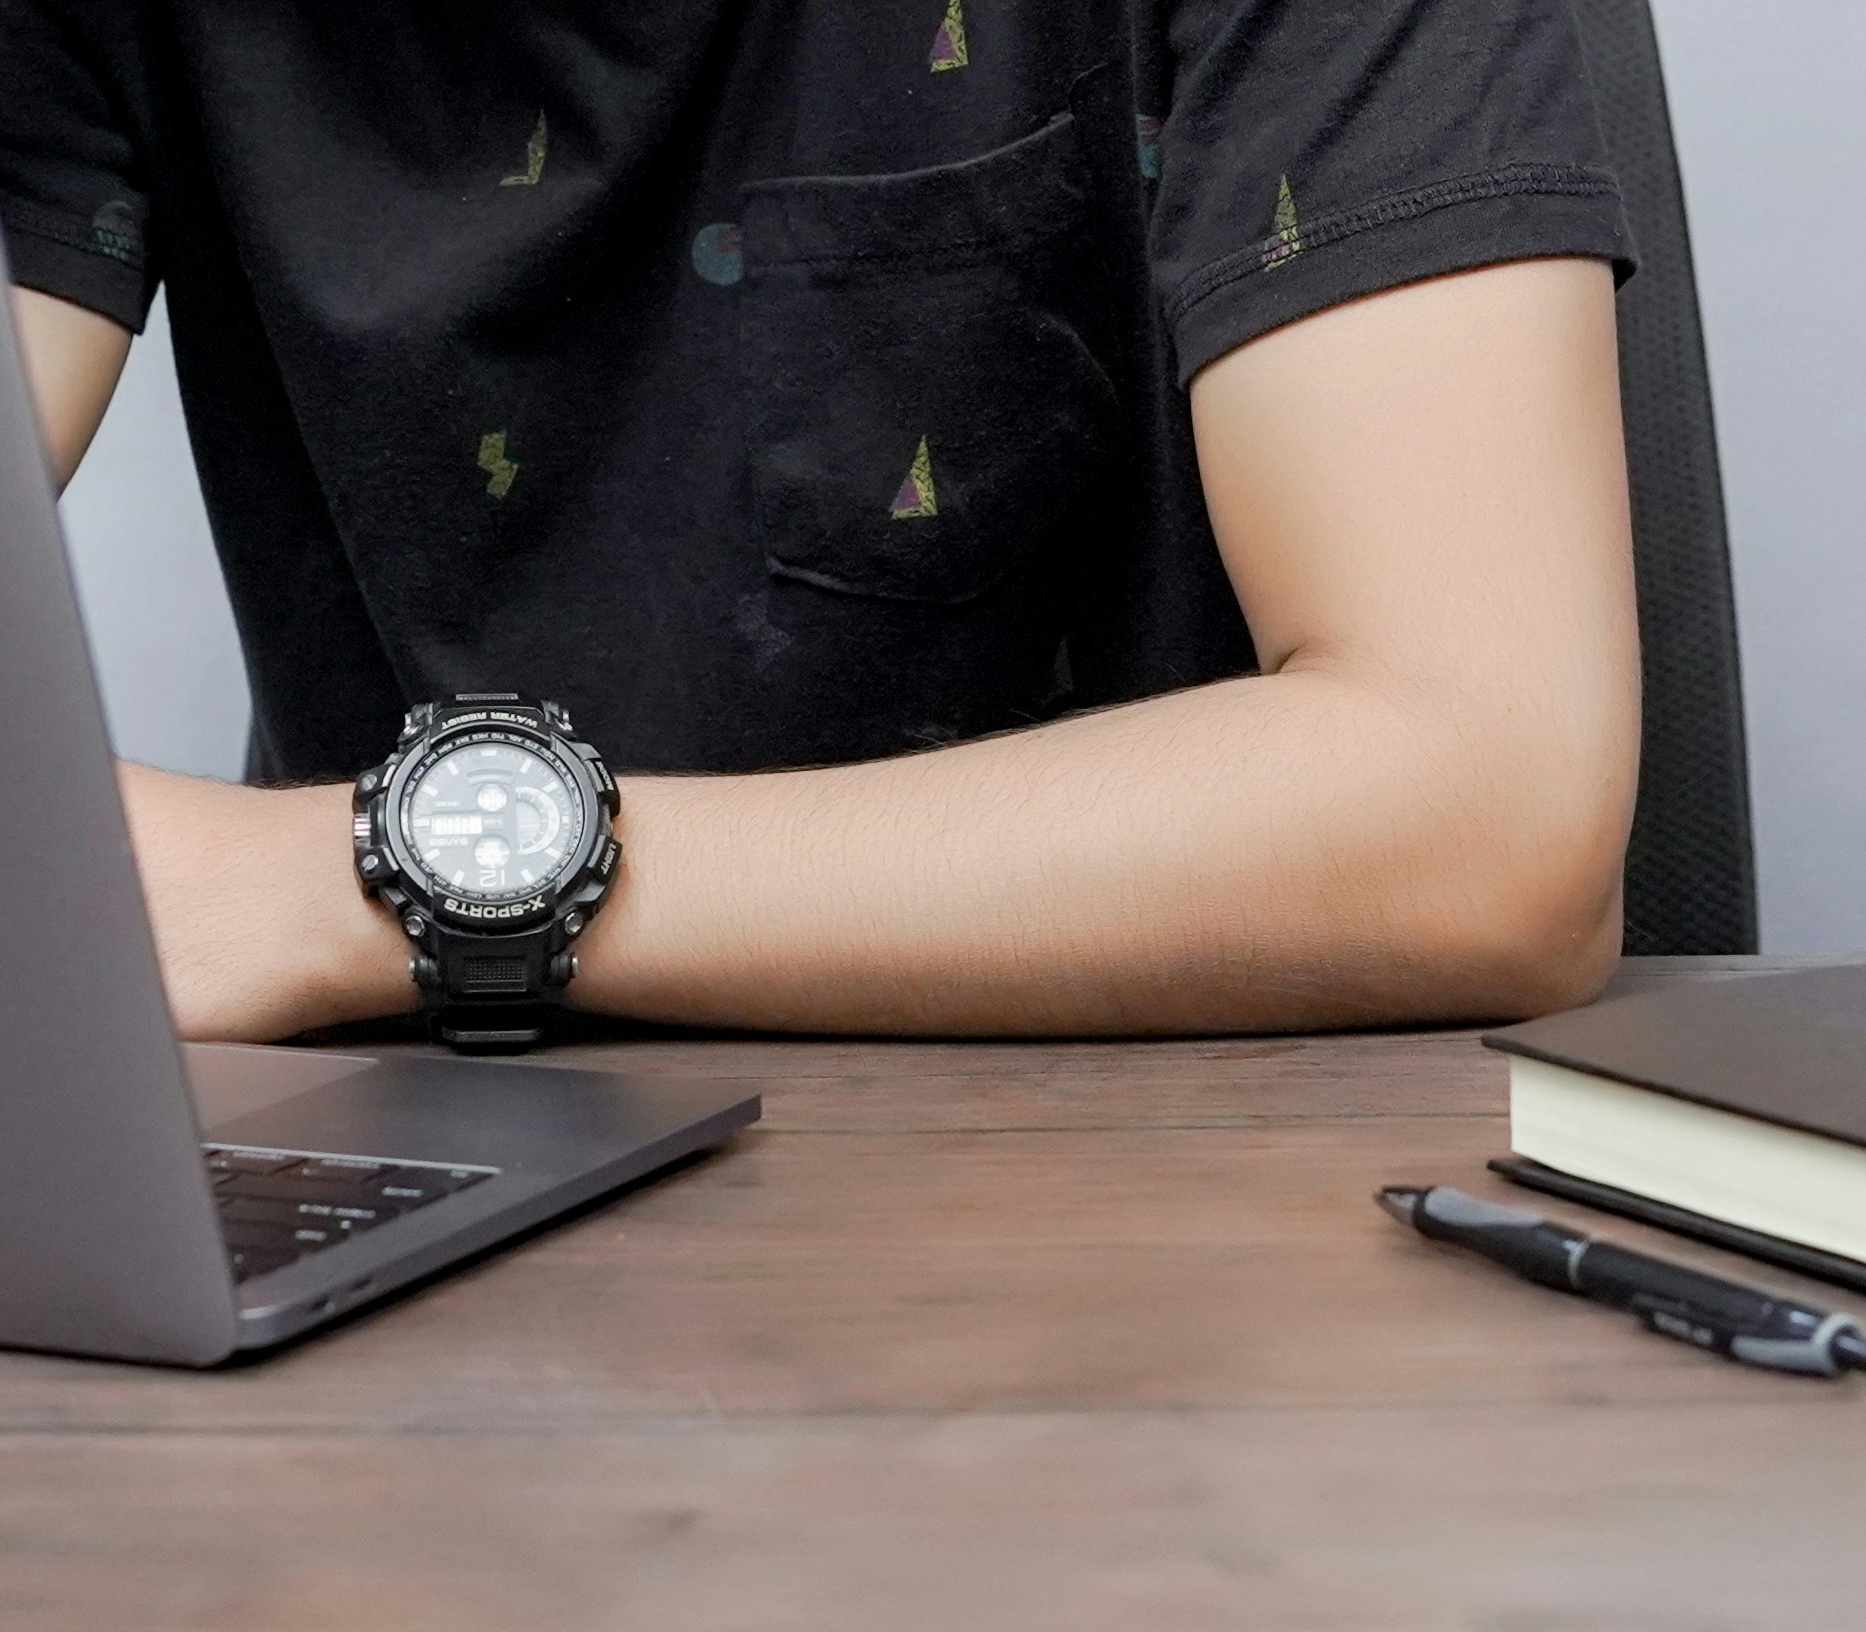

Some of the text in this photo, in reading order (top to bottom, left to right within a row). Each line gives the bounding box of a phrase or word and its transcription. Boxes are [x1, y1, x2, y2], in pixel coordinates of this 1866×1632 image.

[490, 712, 538, 728] WATER
[600, 842, 616, 875] LIGHT
[479, 868, 505, 887] 12
[444, 894, 546, 919] X-SPORTS
